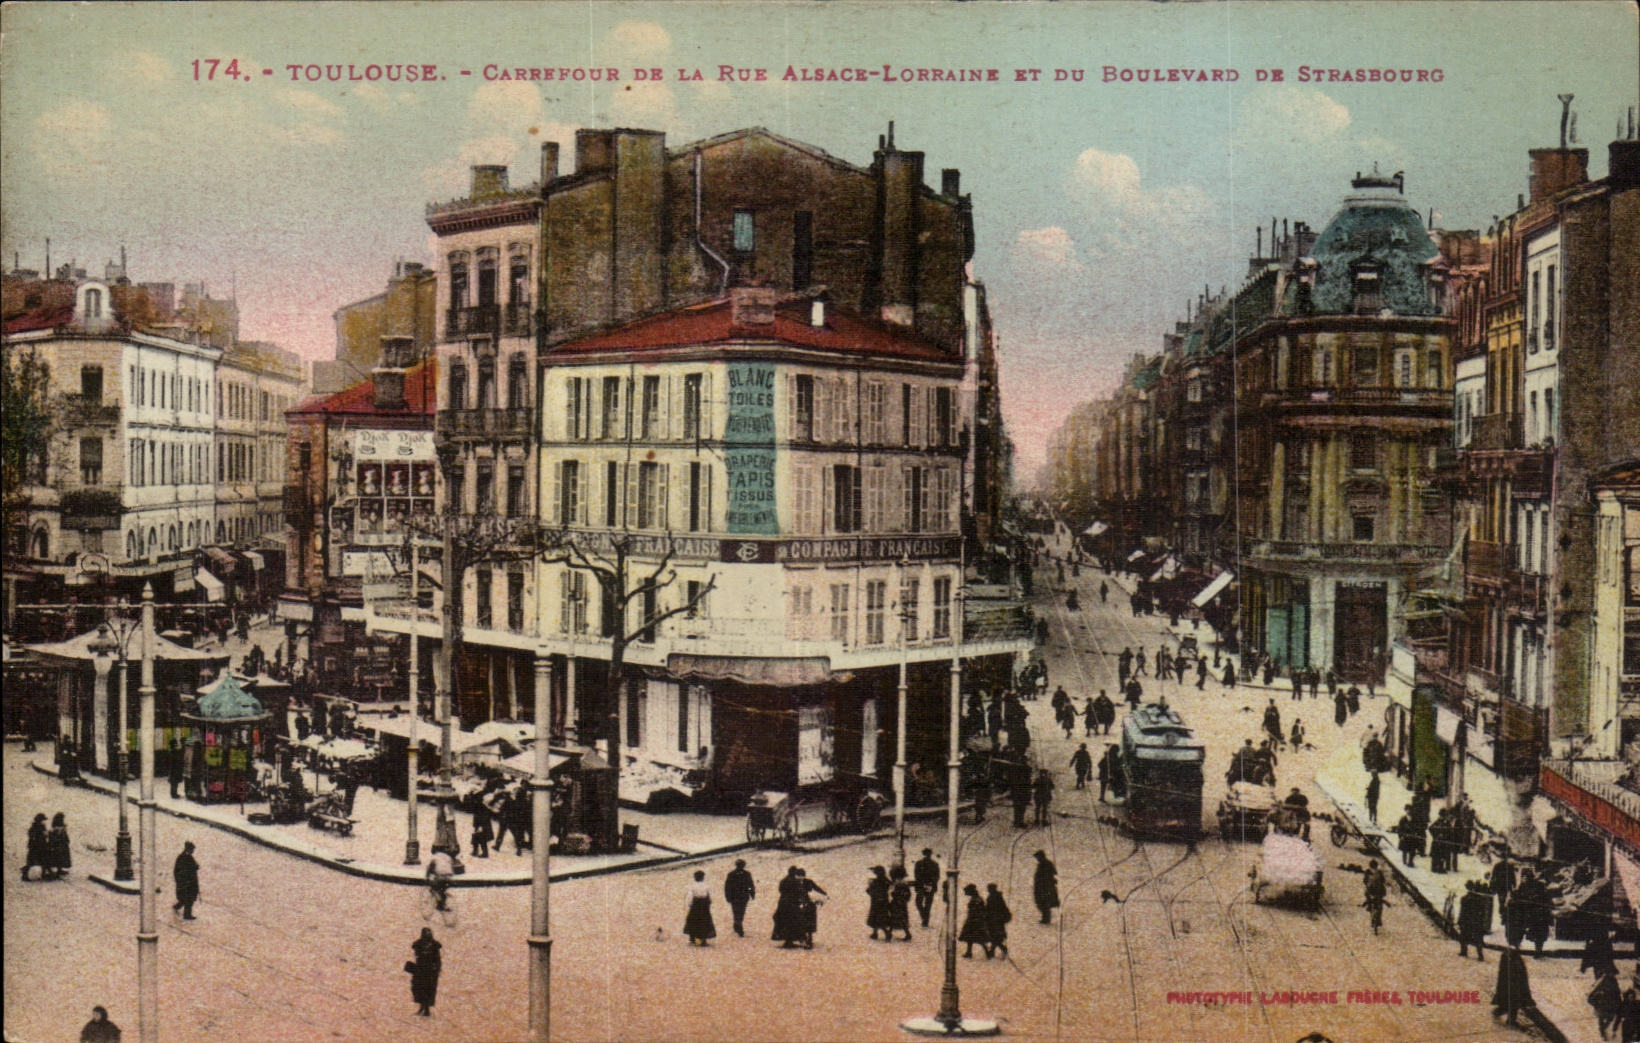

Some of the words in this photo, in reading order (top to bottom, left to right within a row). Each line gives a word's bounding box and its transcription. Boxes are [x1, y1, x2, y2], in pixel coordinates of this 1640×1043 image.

[728, 368, 775, 390] BLANC
[728, 391, 774, 407] TOILES
[726, 471, 775, 488] TAPIS
[726, 489, 774, 502] TISSUS
